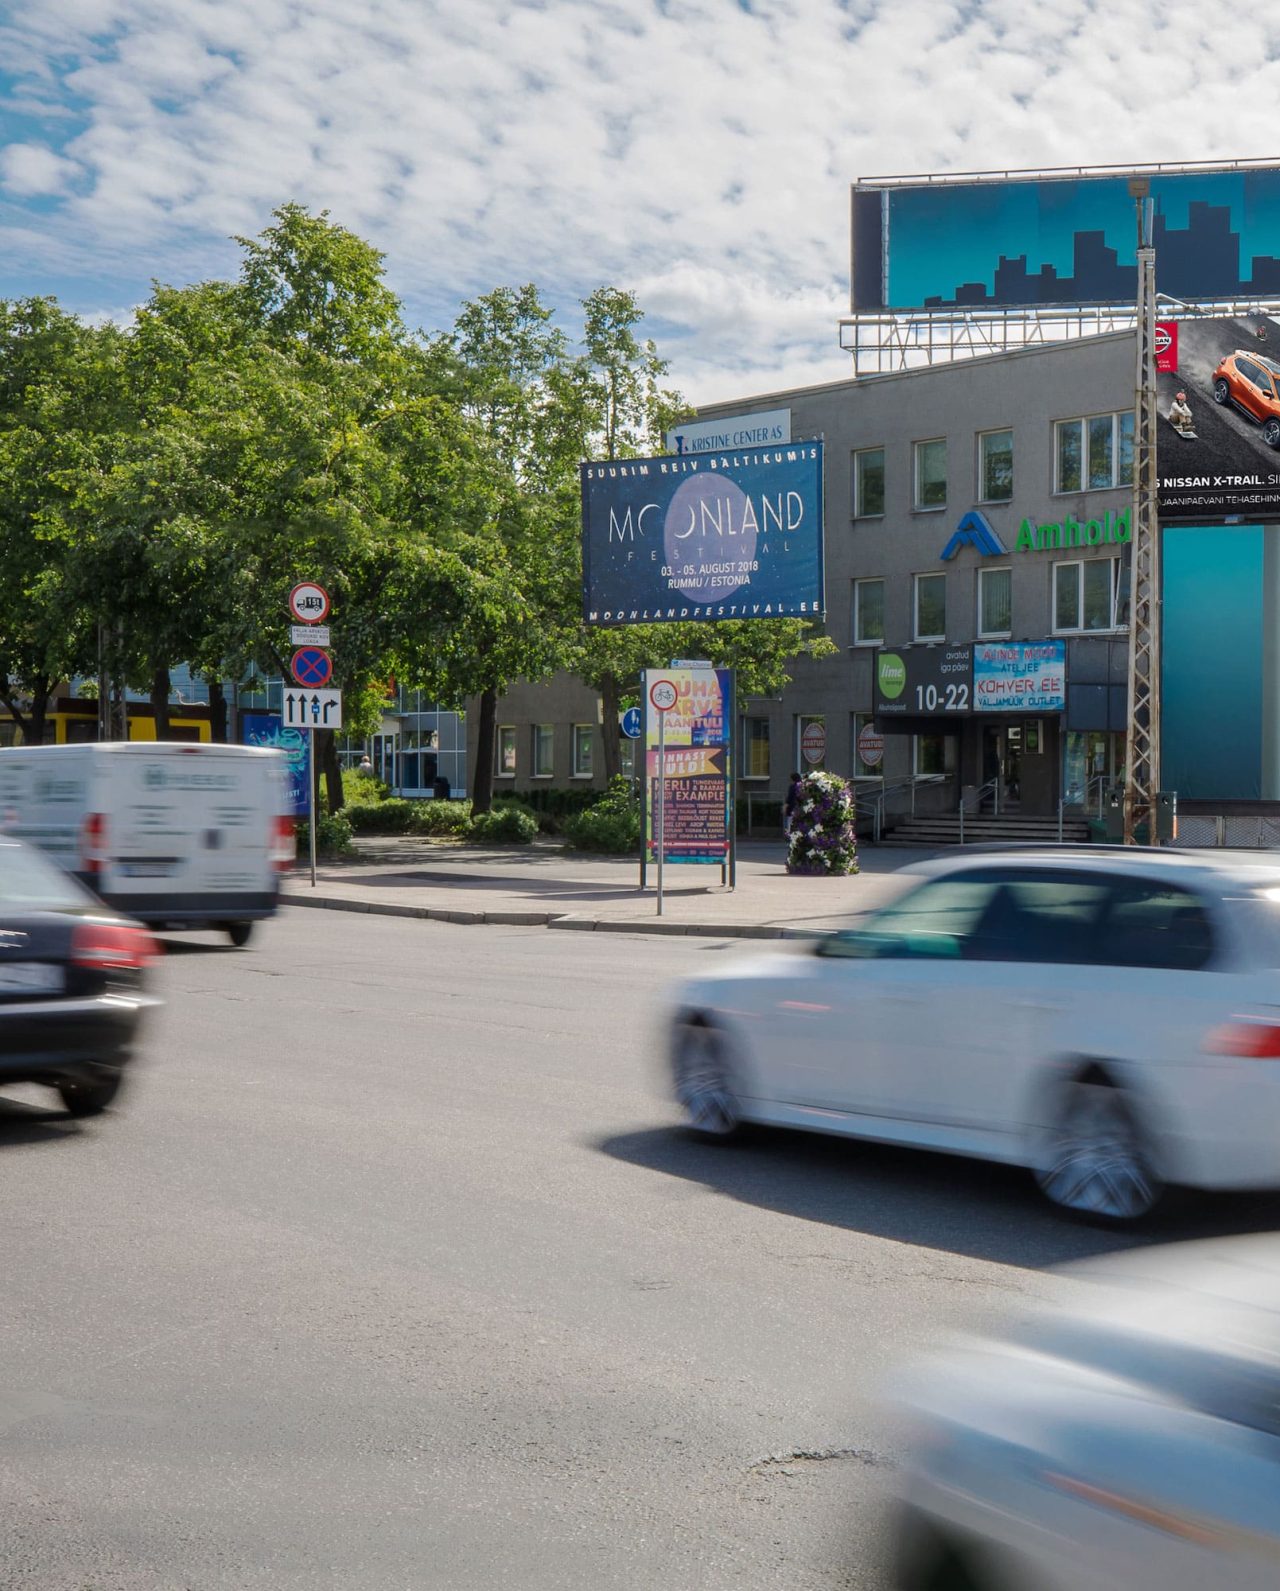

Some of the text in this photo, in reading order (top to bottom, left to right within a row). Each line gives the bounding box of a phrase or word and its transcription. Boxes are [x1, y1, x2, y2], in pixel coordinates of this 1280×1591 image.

[733, 428, 769, 446] CENTER
[770, 425, 783, 439] AS
[587, 448, 817, 479] SUURIM REIV BALTIKUMIS
[1163, 476, 1210, 488] NISSAN
[1213, 474, 1265, 487] X-TRAIL.
[609, 490, 804, 543] MOONLAND
[1015, 505, 1132, 553] Amhold
[627, 541, 790, 561] FESTIVAL
[661, 566, 675, 577] 03.
[683, 565, 697, 576] 05.
[698, 562, 736, 575] AUGUST
[737, 560, 759, 573] 2018
[667, 577, 703, 589] RUMMU
[711, 574, 750, 587] ESTONIA
[589, 601, 819, 621] MOONLANDFESTIVAL.EE
[946, 649, 970, 660] avatud
[881, 664, 903, 678] lime
[940, 660, 970, 674] iga päev
[1001, 662, 1039, 673] ATELJEE
[915, 683, 969, 711] 10-22
[1028, 696, 1061, 706] OUTLET
[676, 791, 725, 801] EXAMPLE
